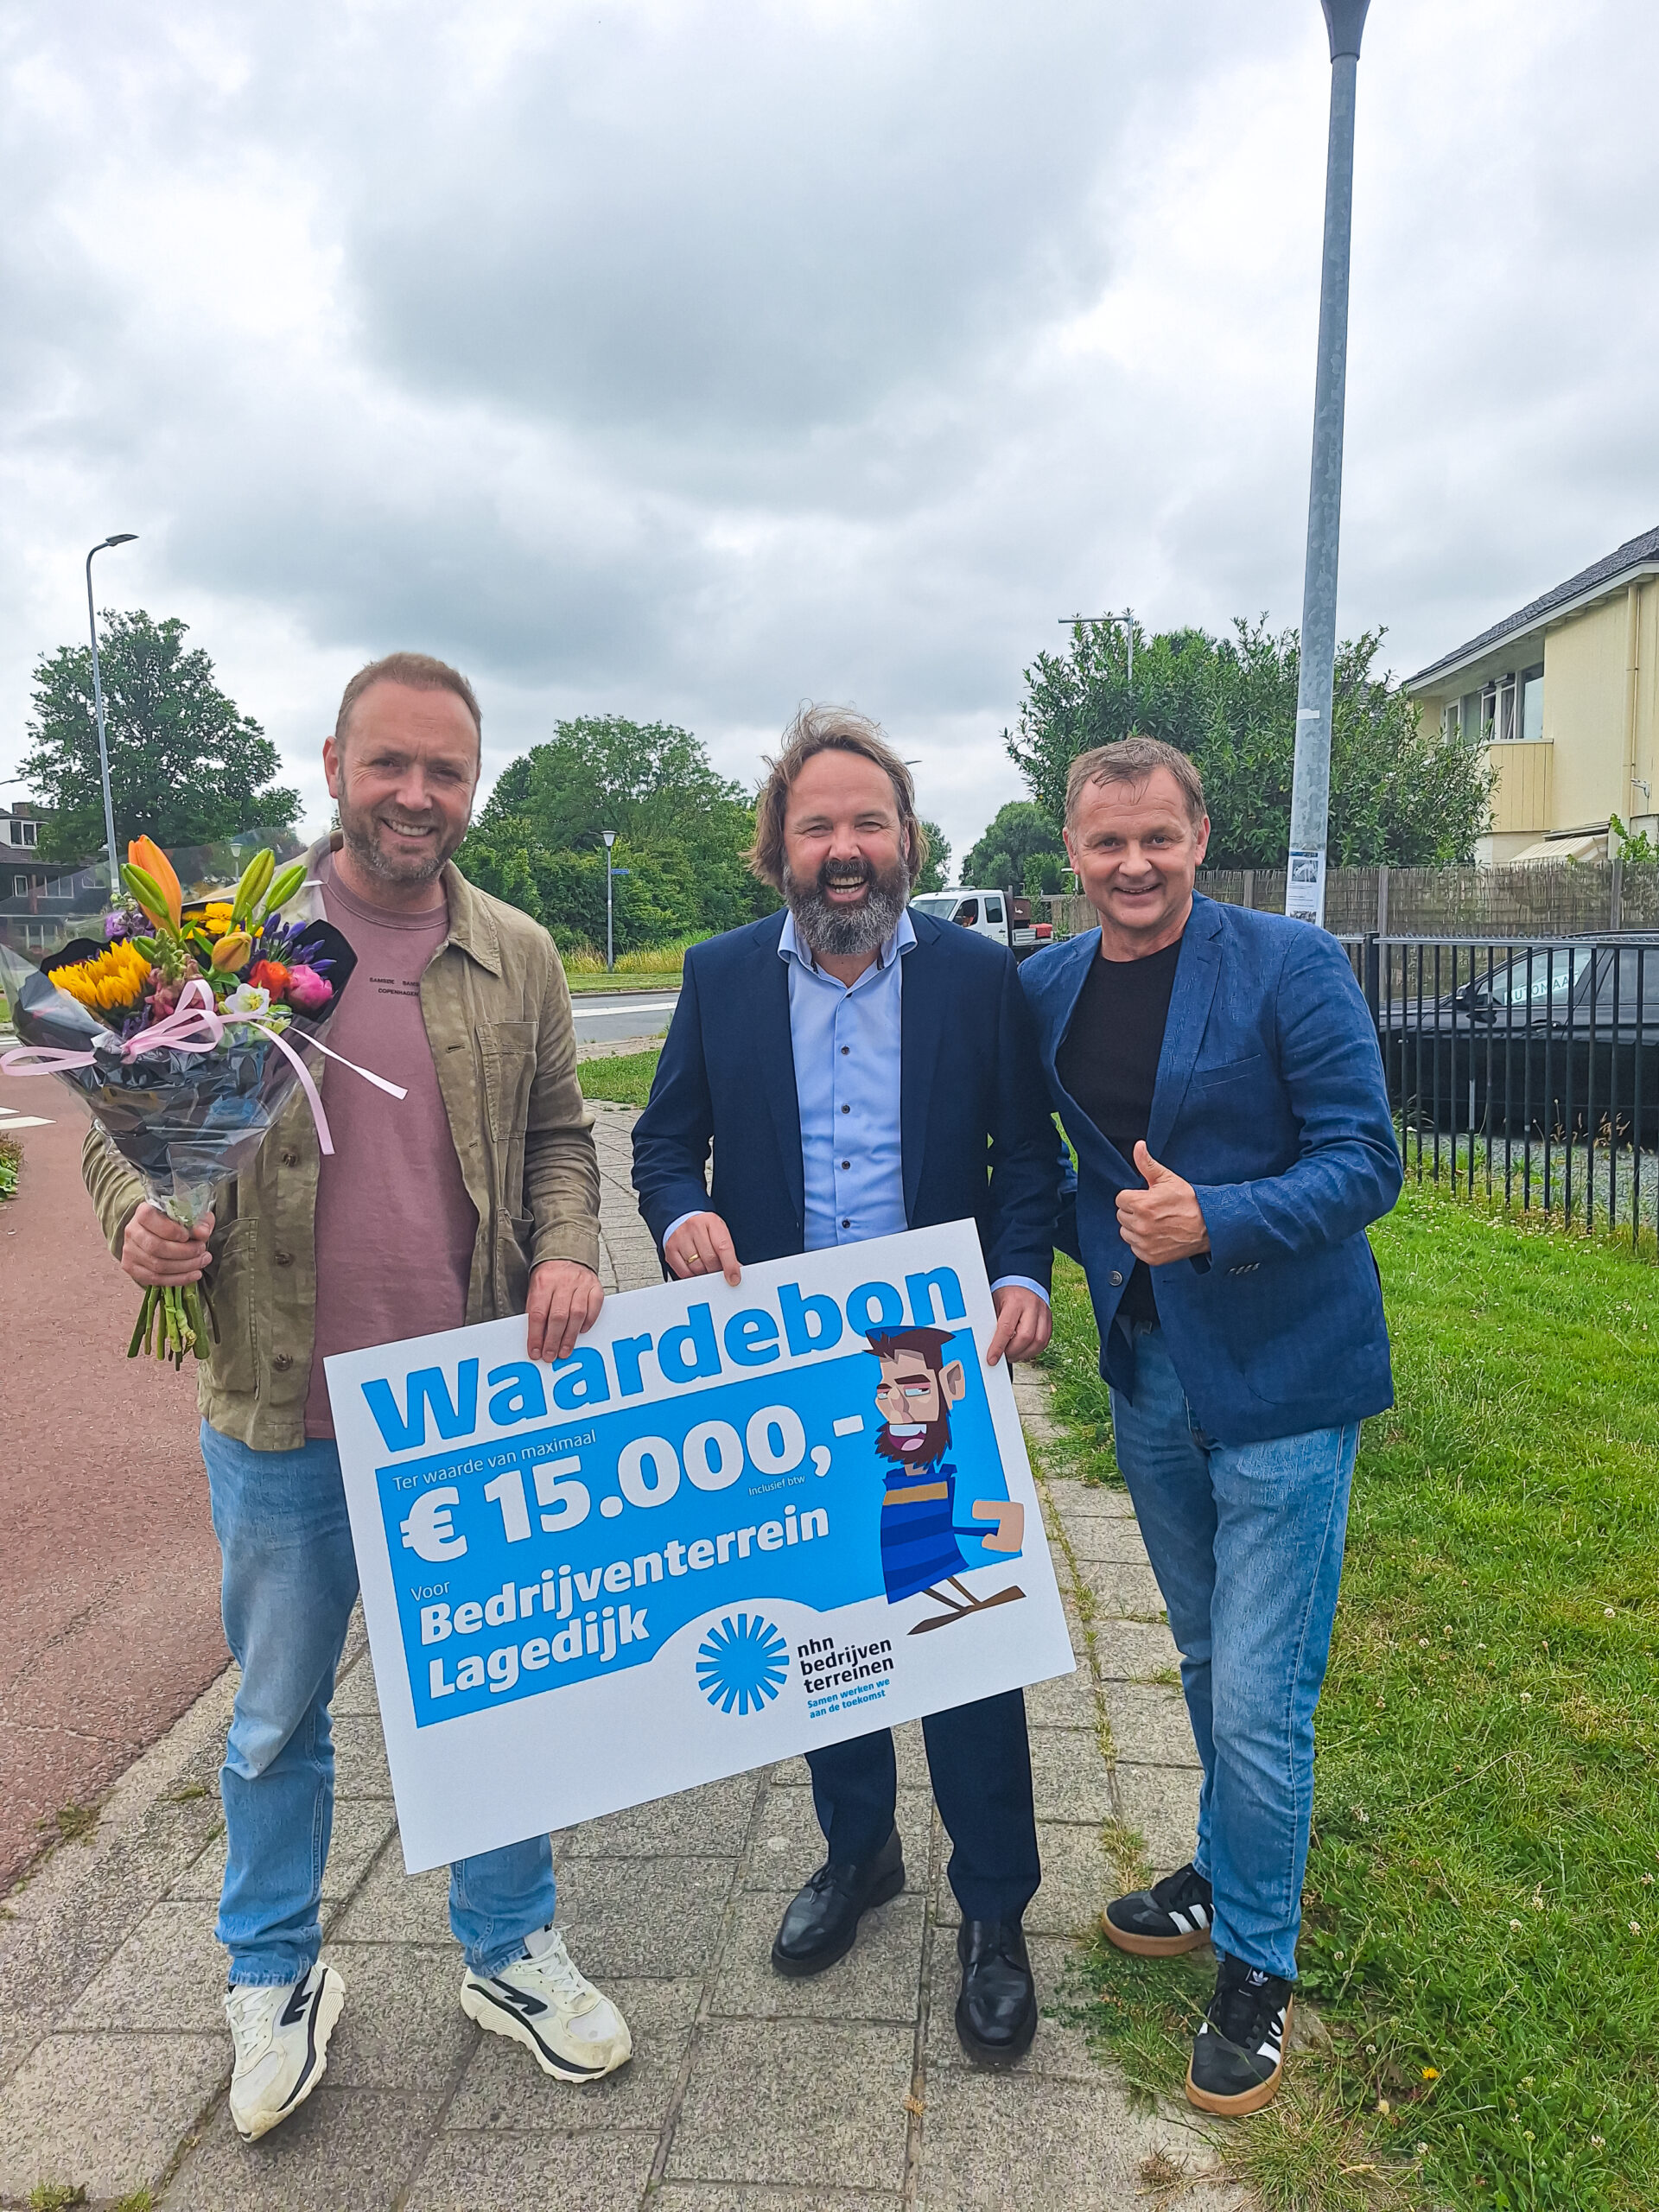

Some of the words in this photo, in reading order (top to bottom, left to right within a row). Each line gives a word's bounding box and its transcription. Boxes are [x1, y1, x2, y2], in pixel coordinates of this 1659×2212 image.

[360, 1267, 967, 1452] Waardebon
[392, 1475, 419, 1491] Ter
[423, 1459, 484, 1484] waarde
[487, 1451, 518, 1469] van
[521, 1428, 597, 1461] maximaal
[399, 1486, 468, 1562] €
[483, 1405, 865, 1543] 15.000,-
[748, 1478, 786, 1497] Inclusief
[787, 1475, 805, 1487] btw
[410, 1581, 450, 1602] Voor
[420, 1503, 830, 1645] Bedrijventerrein
[429, 1604, 650, 1700] Lagedijk
[797, 1637, 835, 1658] nhn
[799, 1639, 893, 1676] bedrijven
[804, 1657, 894, 1694] terreinen
[807, 1694, 839, 1709] Samen
[840, 1683, 874, 1700] werken
[875, 1678, 891, 1688] we
[810, 1707, 827, 1719] aan
[828, 1703, 841, 1713] de
[842, 1689, 887, 1709] toekomst
